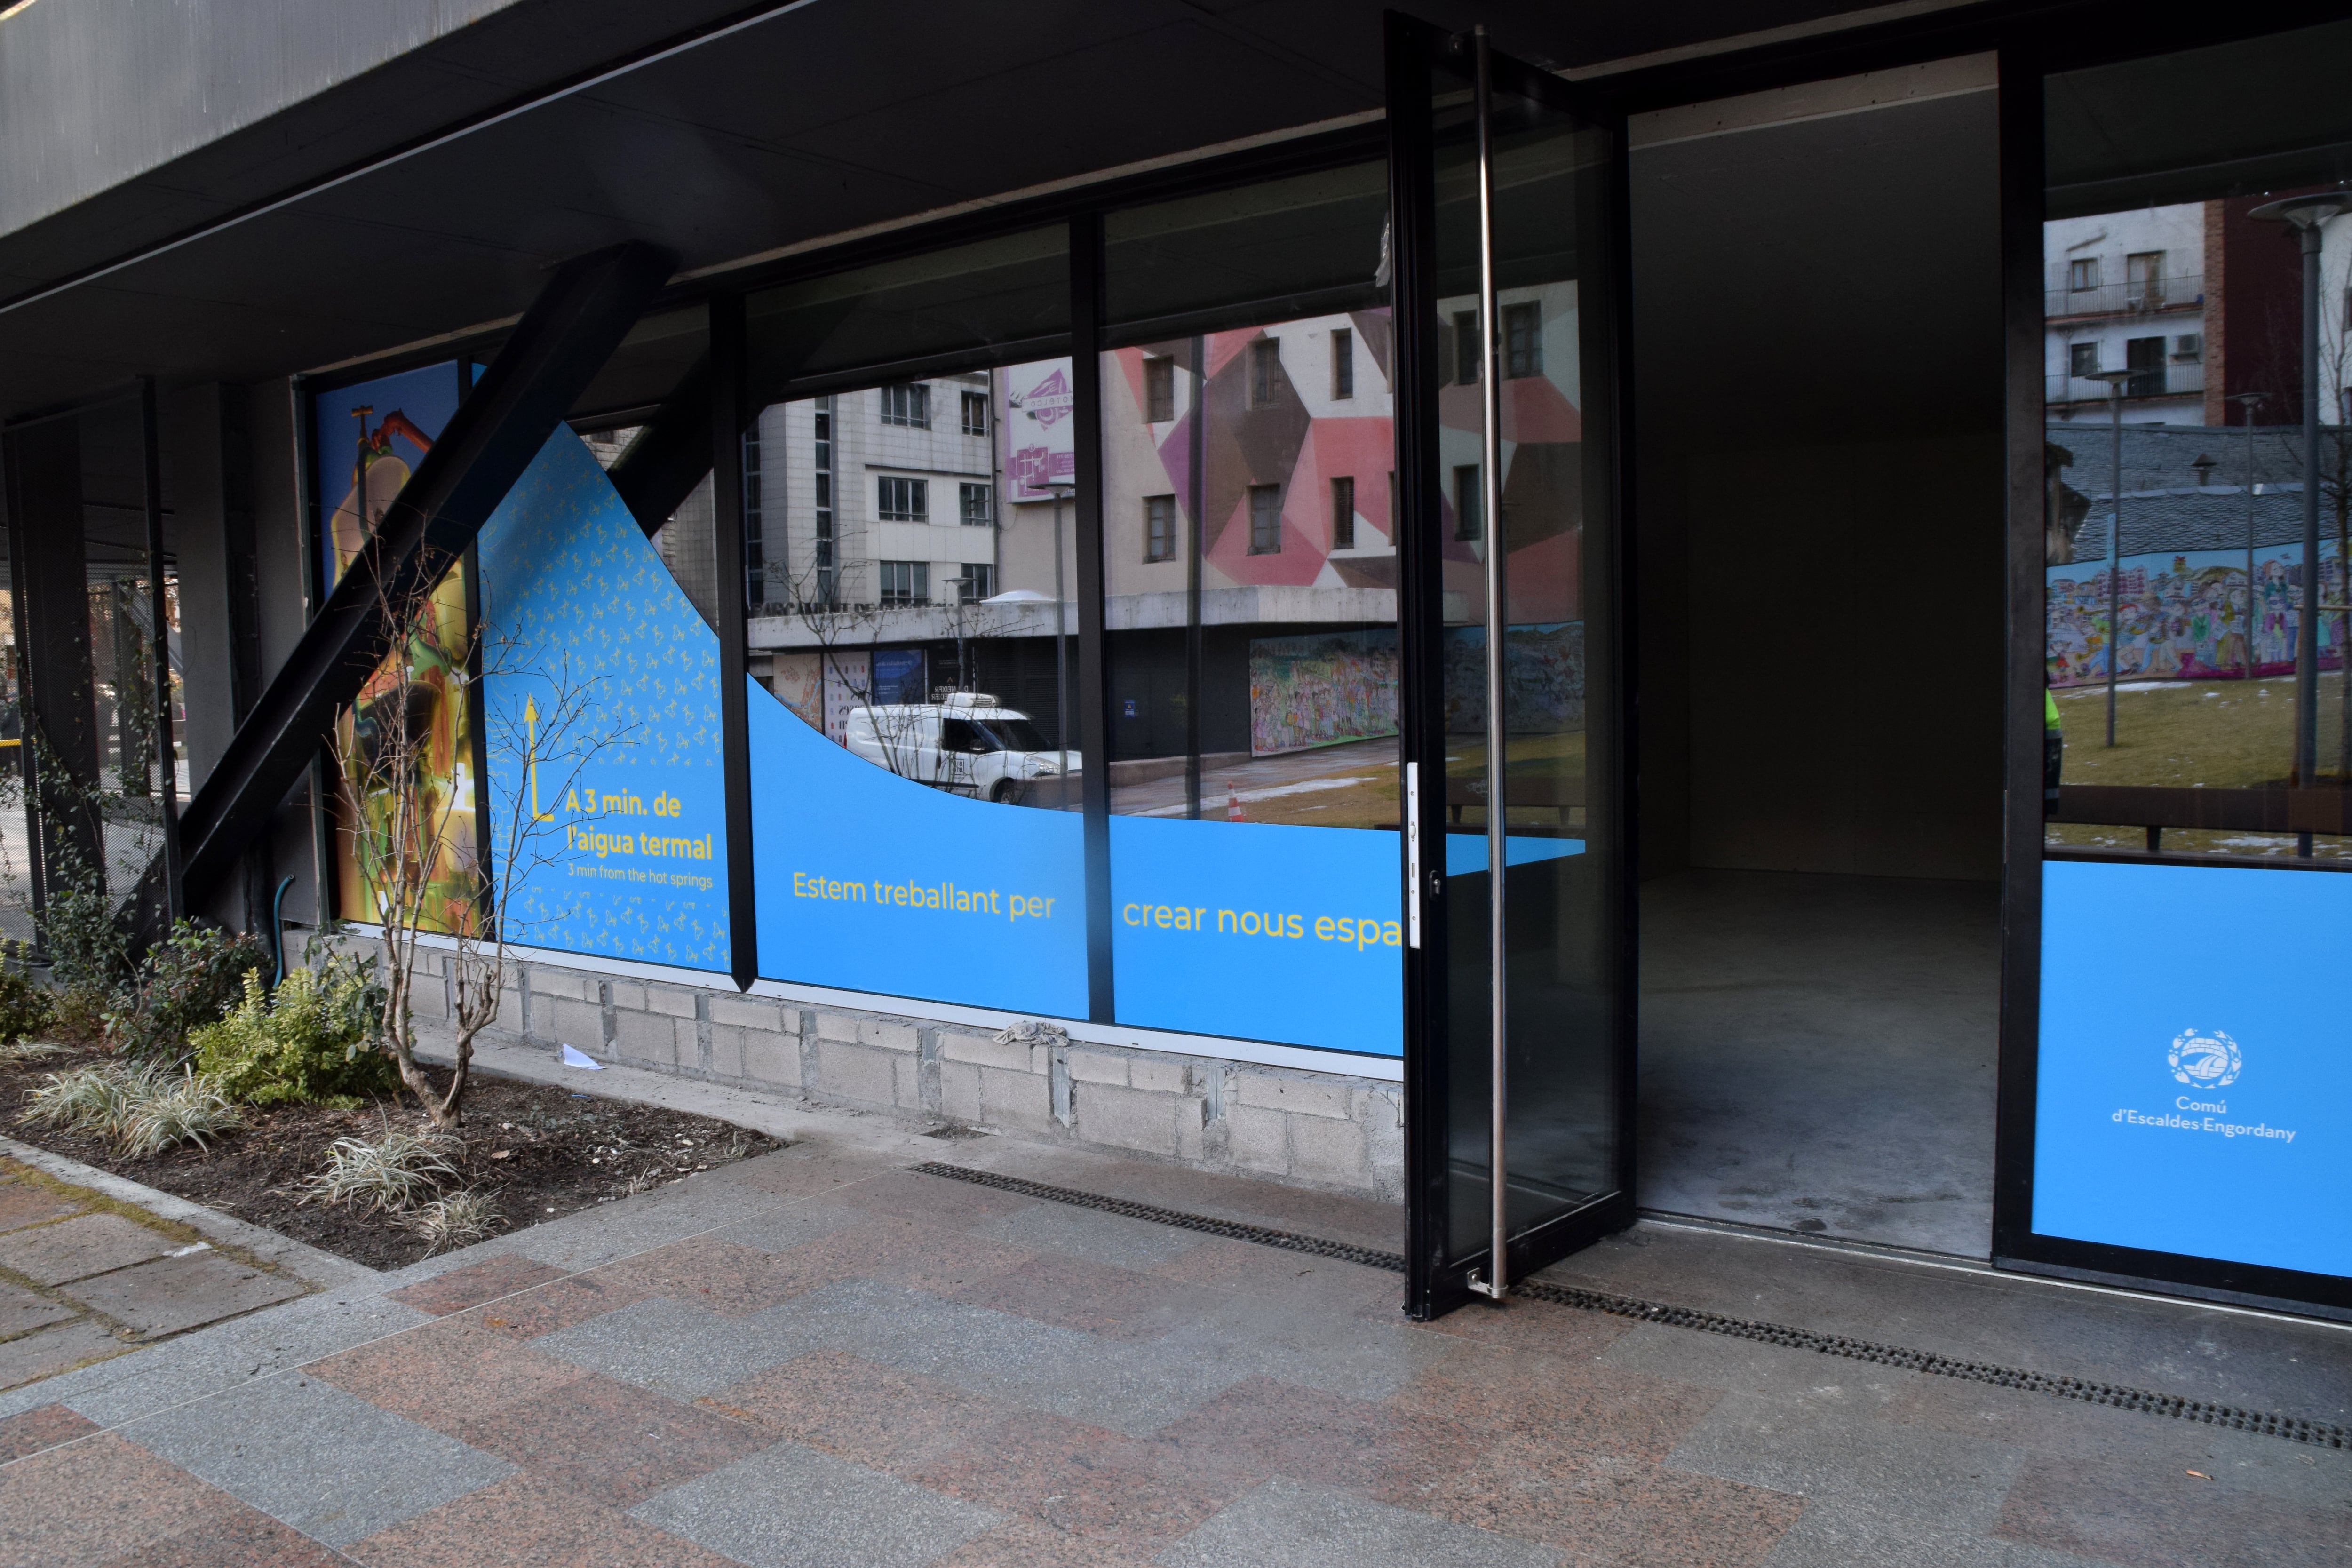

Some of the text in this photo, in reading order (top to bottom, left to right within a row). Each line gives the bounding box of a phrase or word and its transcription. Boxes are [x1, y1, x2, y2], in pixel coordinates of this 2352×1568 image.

[565, 788, 681, 818] A 3 min. de
[567, 824, 712, 860] l'aigua termal
[568, 863, 713, 891] 3 min from the hot springs
[794, 872, 1055, 922] Estem treballant per
[1123, 903, 1402, 951] crear nous espa
[2176, 1096, 2226, 1114] Comú
